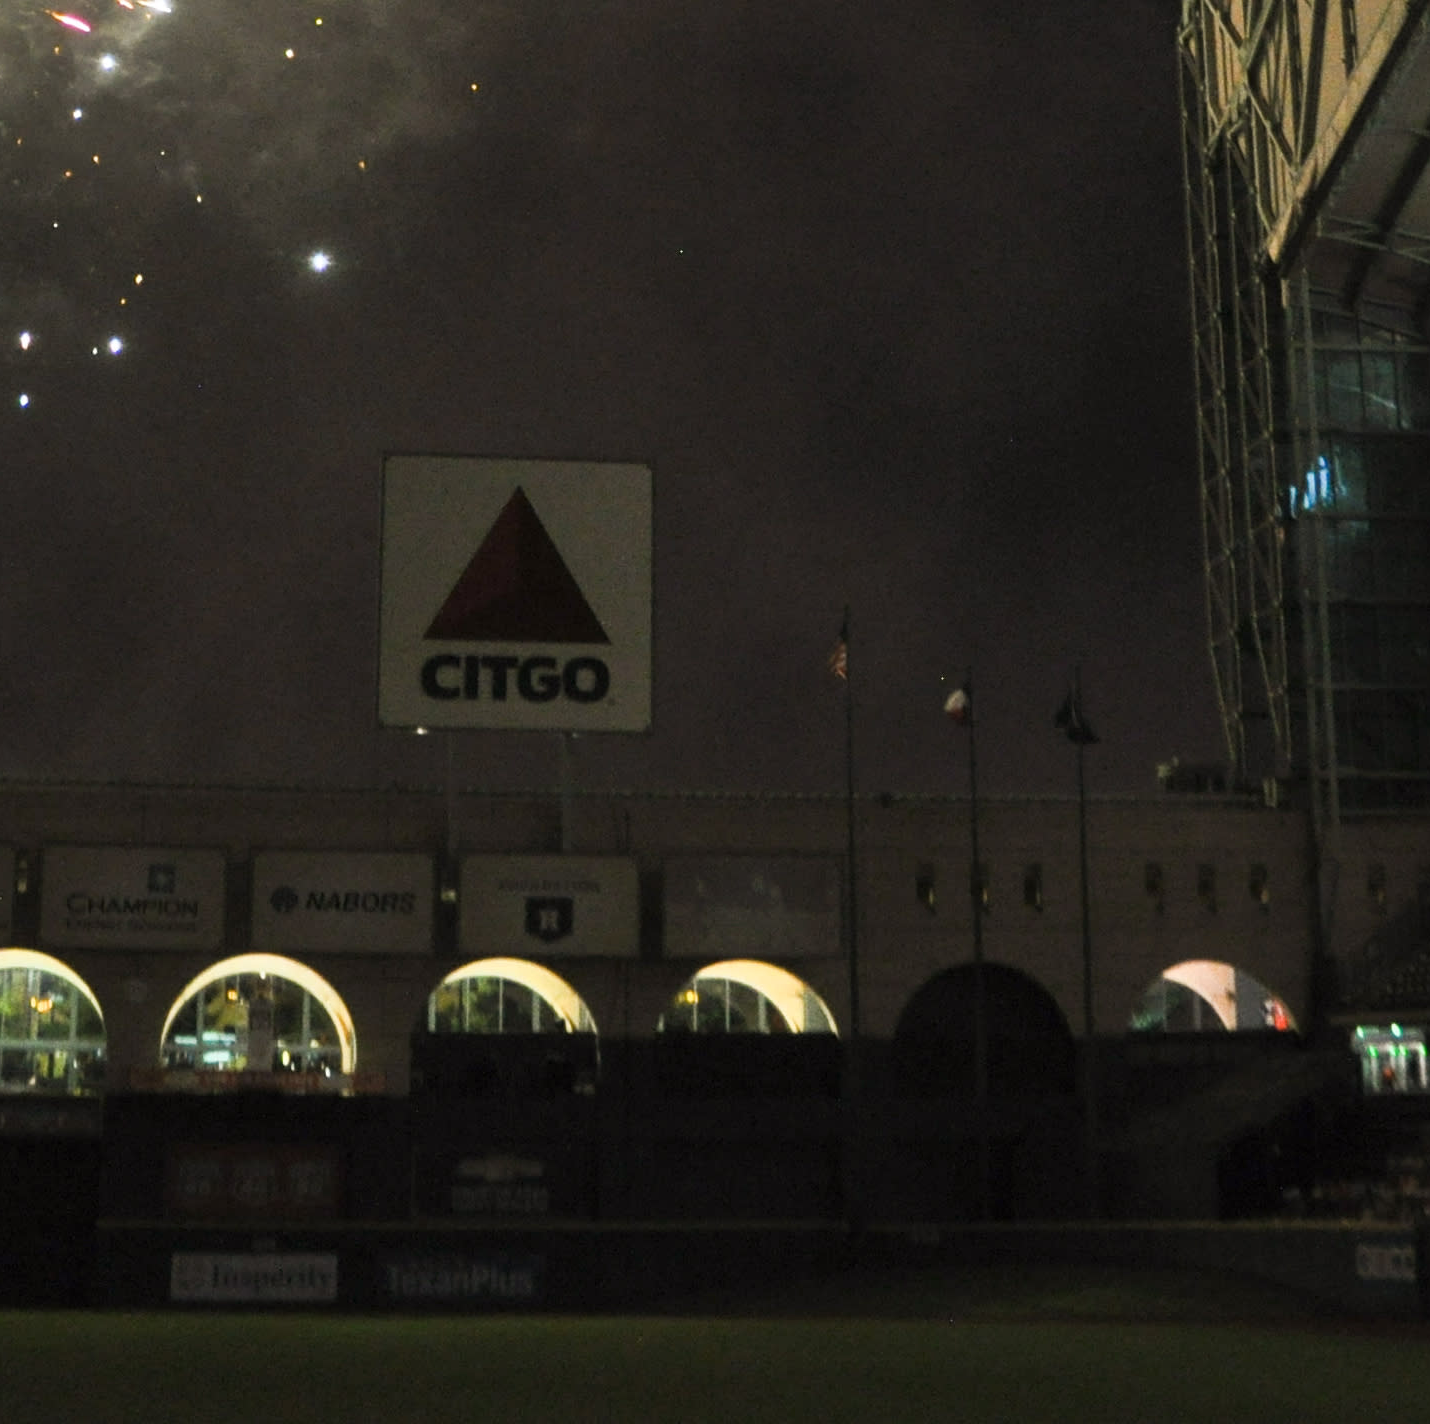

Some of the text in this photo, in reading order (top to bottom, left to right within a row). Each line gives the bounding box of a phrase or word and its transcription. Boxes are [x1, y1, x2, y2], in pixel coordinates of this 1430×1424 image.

[421, 653, 611, 704] CITGO
[64, 892, 199, 917] CHAMPION
[304, 891, 416, 915] NABORS
[386, 1262, 536, 1296] TexanPlus
